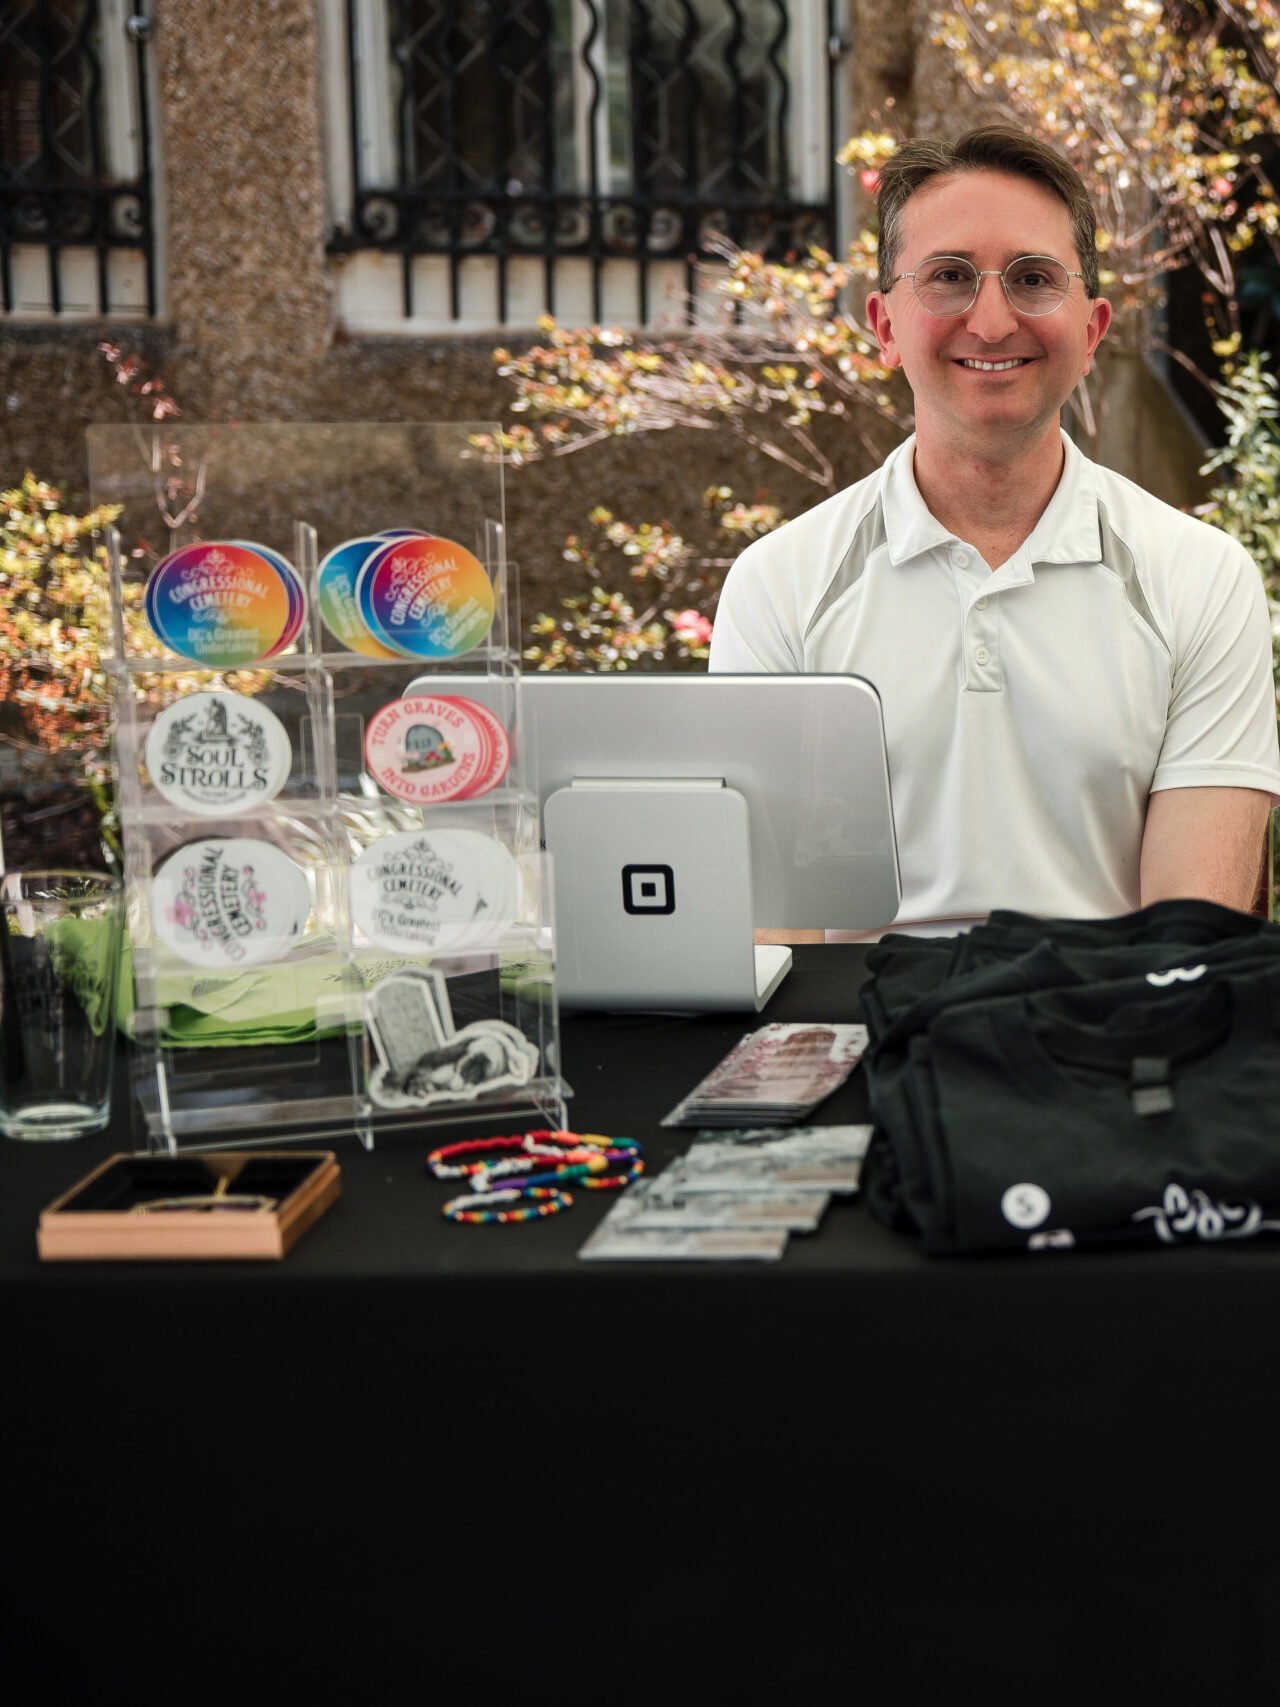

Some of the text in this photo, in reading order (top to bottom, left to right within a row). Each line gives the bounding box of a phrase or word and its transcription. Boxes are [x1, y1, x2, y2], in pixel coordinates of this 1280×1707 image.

[189, 591, 253, 611] CEMETERY
[408, 575, 452, 620] CEMETERY
[372, 701, 465, 746] TURN GRAVES
[187, 745, 244, 767] SOUL
[161, 763, 270, 790] STROLLS
[381, 767, 416, 795] INTO
[419, 752, 476, 797] GARDENS
[220, 864, 253, 936] CEMETERY
[383, 879, 445, 900] CEMETERY
